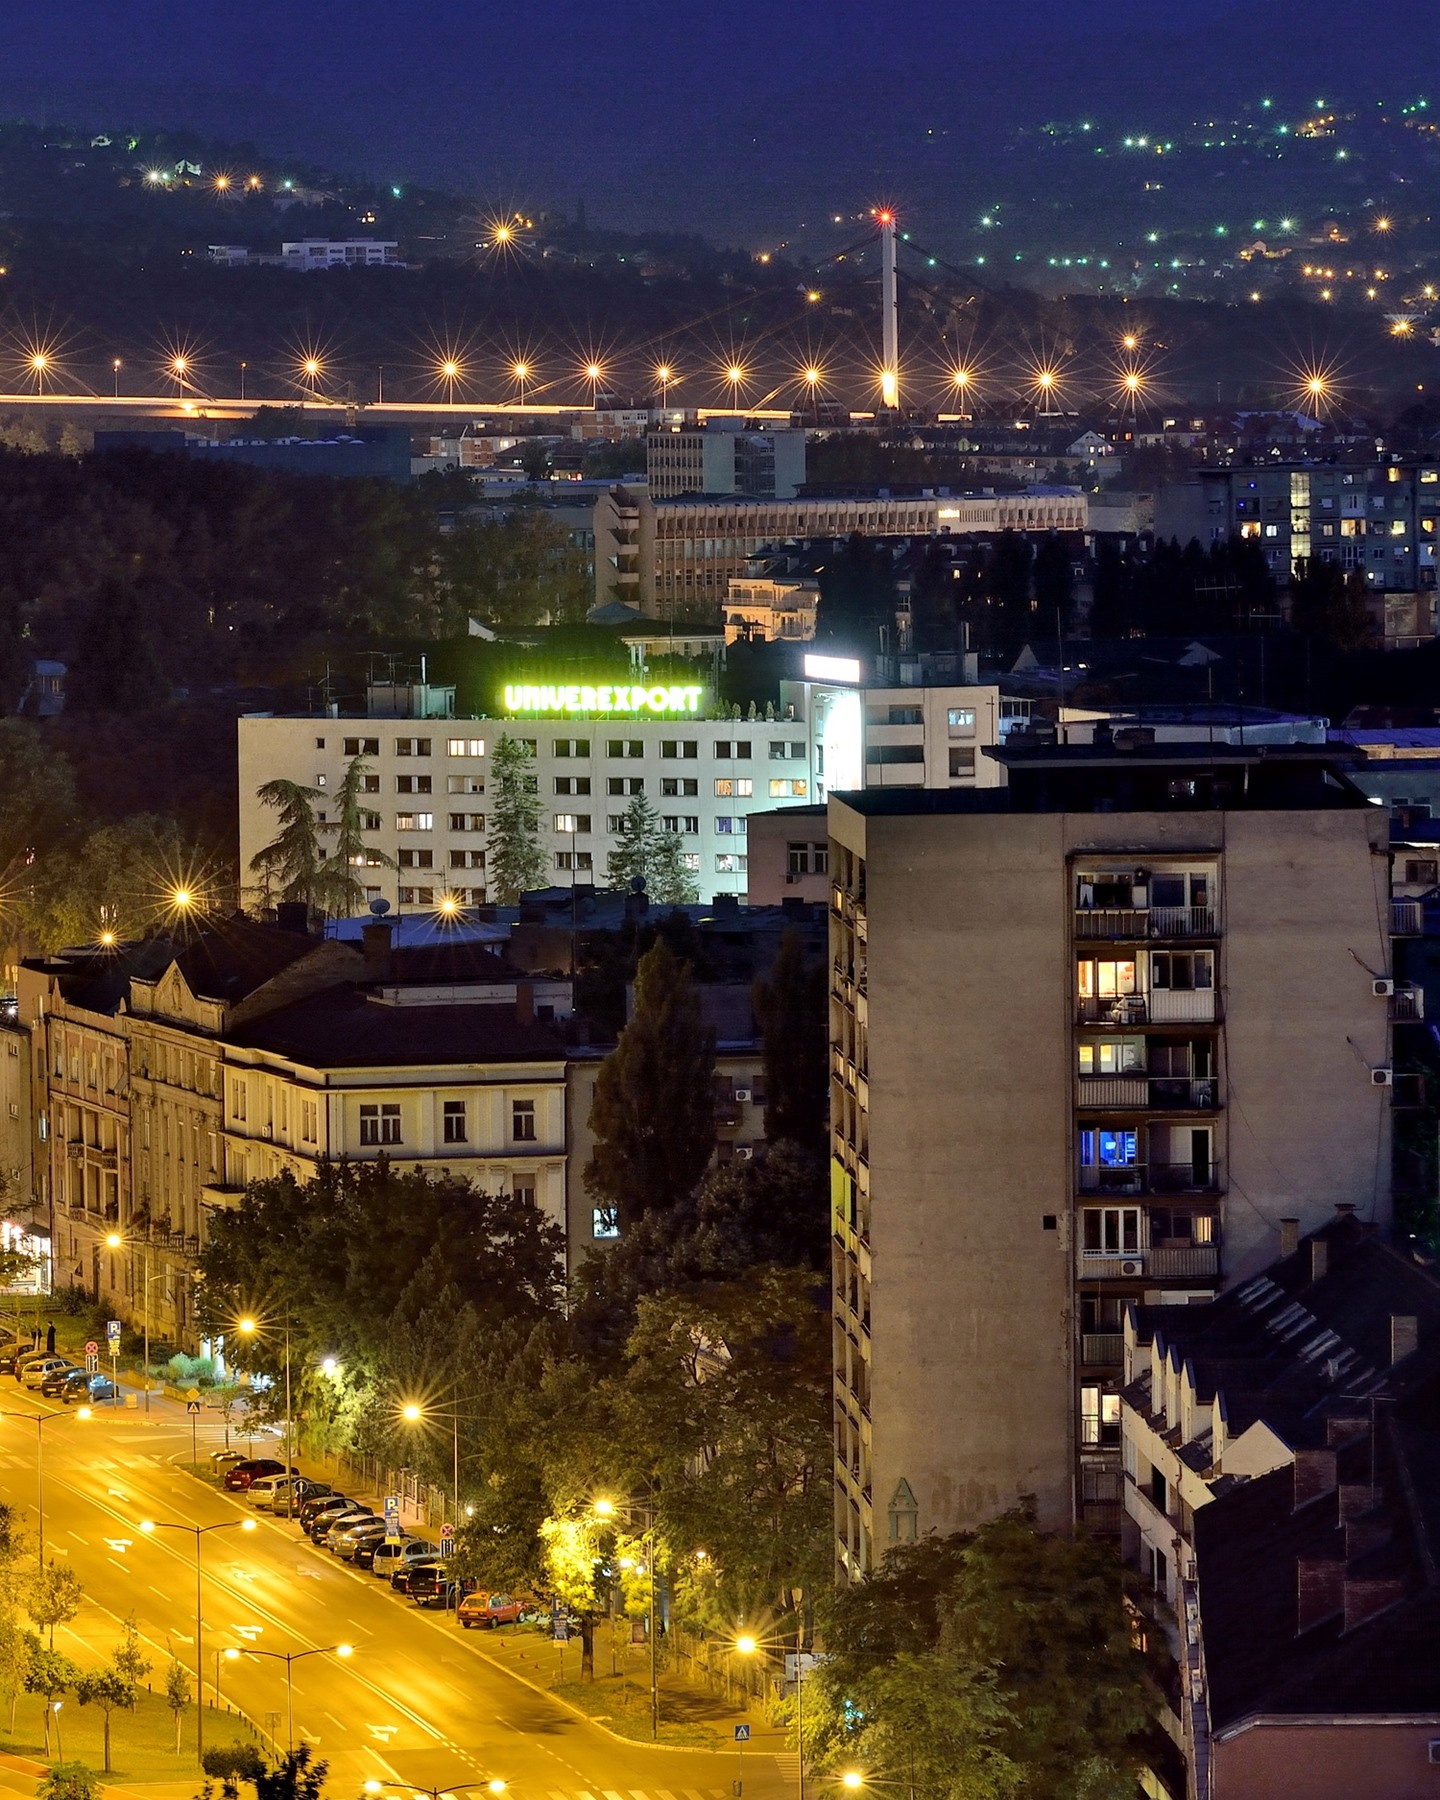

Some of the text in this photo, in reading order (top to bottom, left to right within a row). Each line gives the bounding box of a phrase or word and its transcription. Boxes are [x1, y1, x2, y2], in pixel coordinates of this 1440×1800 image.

[504, 685, 703, 712] UNIVEREXPORT
[110, 1323, 117, 1333] P
[387, 1498, 396, 1509] P
[555, 1599, 564, 1610] P
